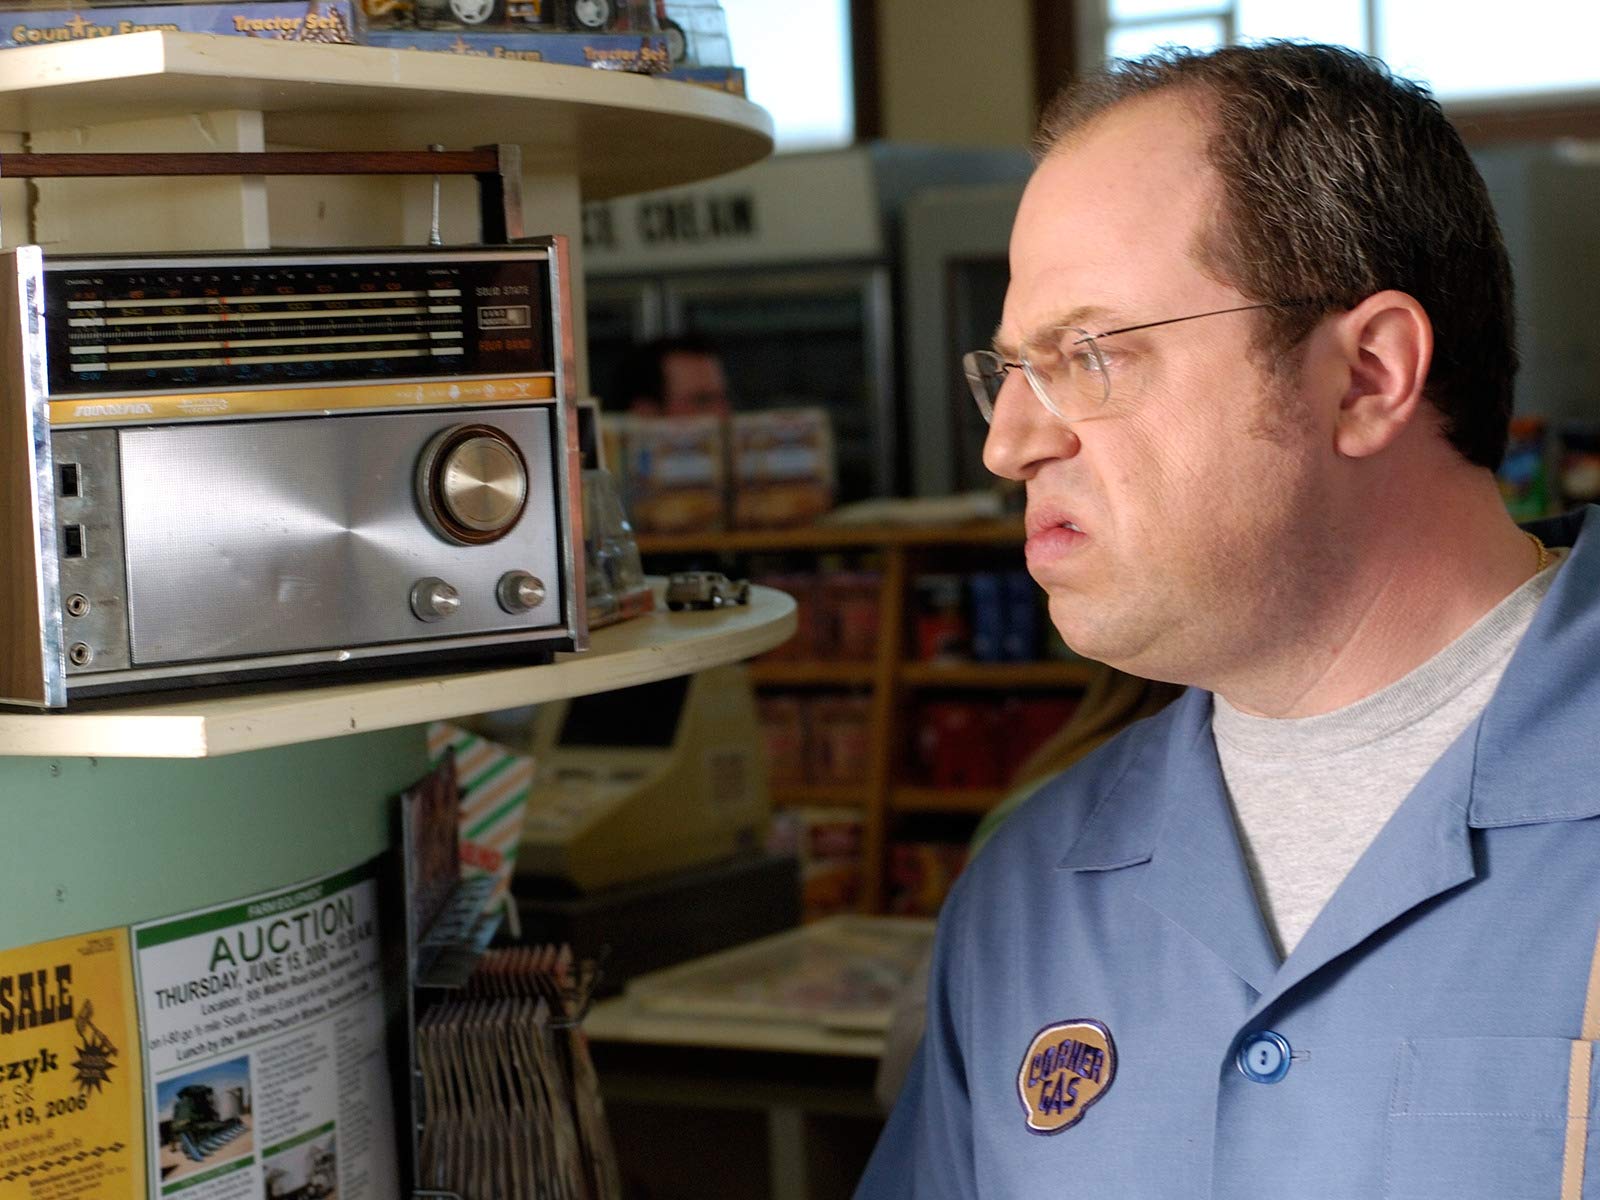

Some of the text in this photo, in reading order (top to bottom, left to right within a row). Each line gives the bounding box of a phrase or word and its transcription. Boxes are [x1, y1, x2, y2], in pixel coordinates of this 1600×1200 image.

[233, 12, 339, 32] Tractor Set
[208, 895, 355, 973] AUCTION
[0, 964, 74, 1035] SALE
[155, 969, 243, 1010] THURSDAY,
[246, 953, 283, 986] JUNE
[0, 1048, 59, 1084] zyk
[1027, 1038, 1105, 1089] CORNER
[16, 1105, 41, 1126] 19,
[46, 1094, 88, 1119] 2006
[1038, 1071, 1082, 1116] GAS
